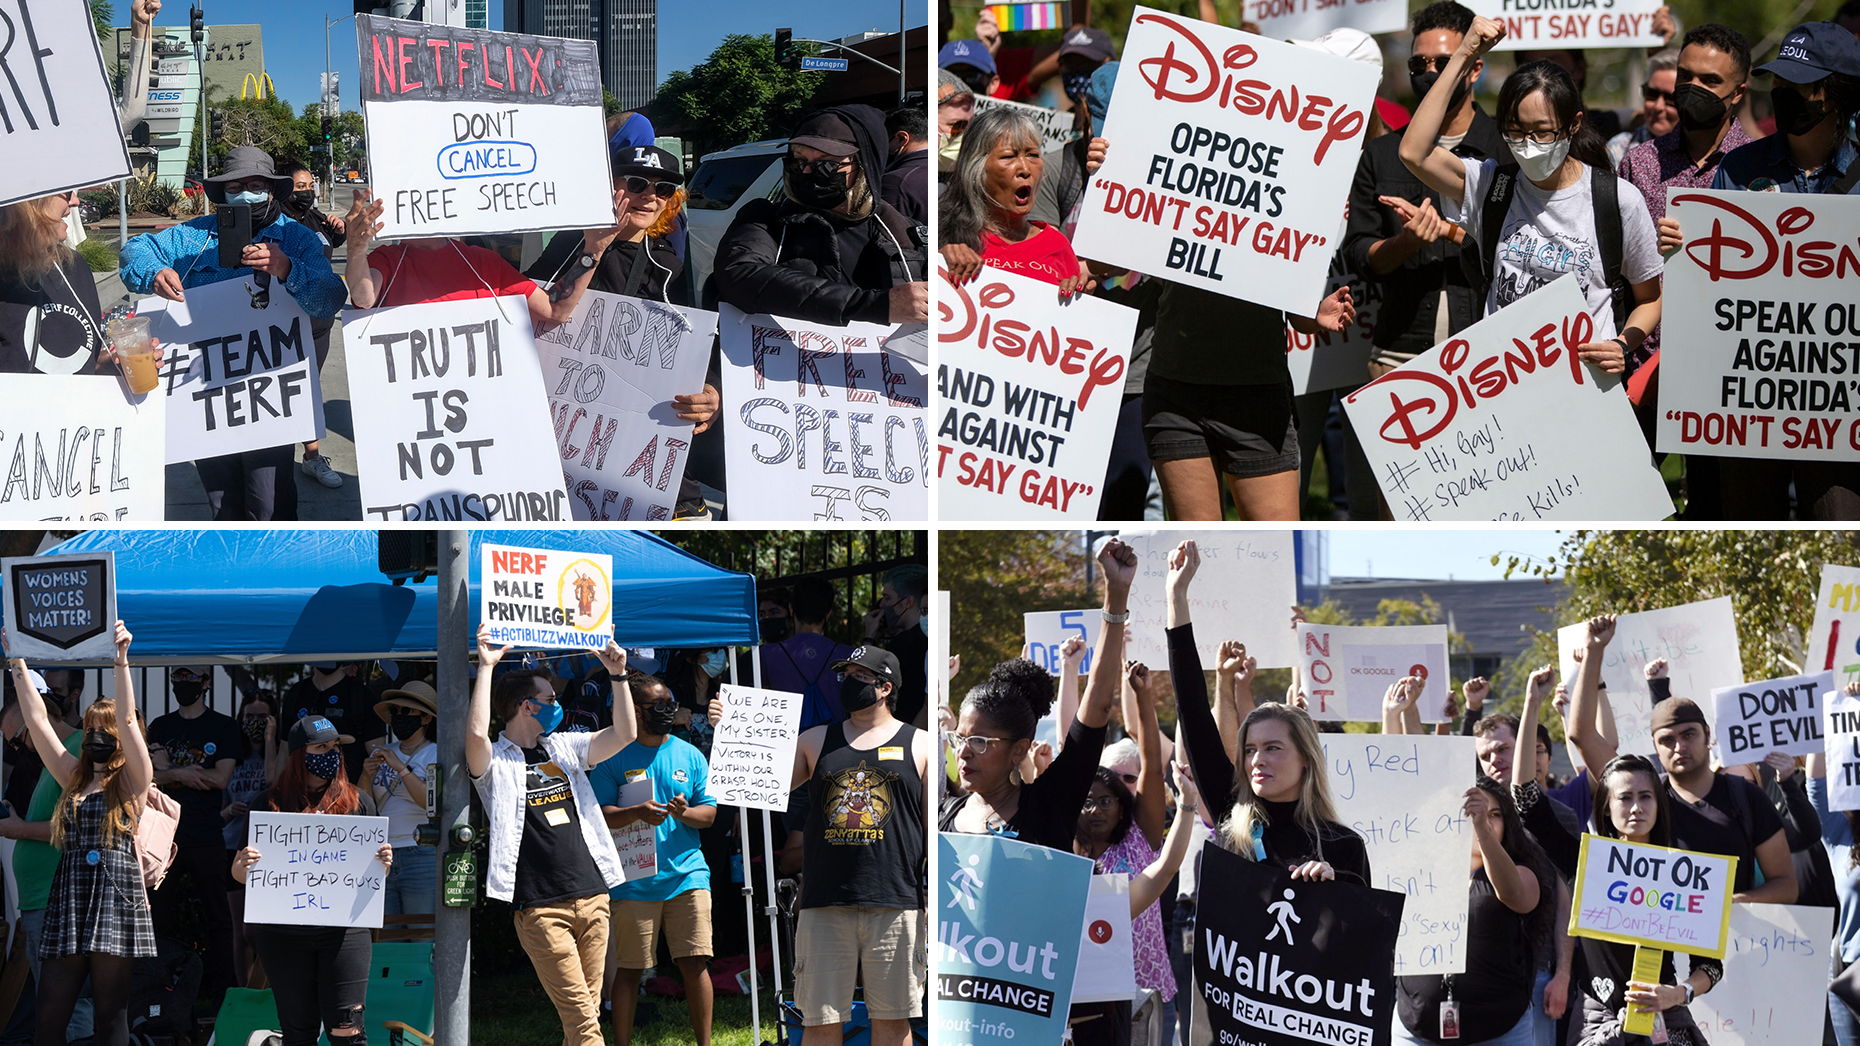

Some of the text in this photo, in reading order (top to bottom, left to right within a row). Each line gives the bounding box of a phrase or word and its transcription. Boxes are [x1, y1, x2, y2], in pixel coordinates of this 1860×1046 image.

[1549, 14, 1591, 39] SAY
[805, 59, 845, 70] De Longpre
[453, 109, 519, 142] DON'T
[449, 148, 521, 173] CANCEL
[633, 147, 663, 169] LA
[1171, 122, 1284, 178] OPPOSE
[396, 181, 557, 224] FREE SPEECH
[1147, 154, 1286, 217] FLORIDA'S
[1095, 178, 1327, 263] "DON'T SAY GAY"
[983, 258, 1060, 279] PEAK OUT
[1166, 237, 1224, 281] BILL
[63, 304, 94, 350] COLLECTIVE
[1715, 298, 1817, 335] SPEAK
[159, 316, 305, 396] #TEAM
[370, 319, 503, 383] TRUTH
[752, 325, 924, 409] FREE
[555, 357, 606, 404] TO
[1721, 375, 1860, 412] FLORIDA'
[191, 369, 307, 431] TERF
[412, 389, 469, 440] IS
[1004, 381, 1076, 432] WITH
[938, 407, 1065, 468] AGAINST
[1666, 410, 1775, 447] "DON'T
[1782, 416, 1842, 450] SAY
[0, 426, 130, 503] ANCEL
[397, 439, 494, 481] NOT
[622, 434, 689, 492] AT
[956, 452, 1016, 495] SAY
[1019, 469, 1094, 513] GAY"
[24, 569, 88, 589] WOMENS
[491, 550, 547, 575] NERF
[30, 589, 84, 608] VOICES
[493, 580, 544, 599] MALE
[28, 608, 91, 628] MATTER!
[488, 602, 576, 627] PRIVILEGE
[489, 627, 611, 648] #ACTIBLIZZWALKOUT
[730, 710, 788, 726] AS ONE,
[762, 696, 788, 709] ARE
[1738, 682, 1818, 720] DON'T
[720, 724, 741, 738] MY
[1728, 722, 1764, 753] BE
[1770, 716, 1824, 747] EVIL
[712, 764, 774, 775] WITHIN OUR
[761, 751, 773, 761] IS
[1366, 743, 1419, 775] Red
[528, 791, 573, 806] LEAGUE
[711, 775, 780, 789] GRASP. HOLD
[254, 824, 386, 846] FIGHT BAD GUYS
[288, 850, 347, 864] IN GAME
[1671, 856, 1712, 891] OK
[249, 869, 381, 891] FIGHT BAD GUYS
[1607, 880, 1705, 914] GOOGLE
[292, 893, 330, 910] IRL
[1734, 929, 1814, 967] rights
[1206, 927, 1375, 1017] Walkout
[958, 979, 1050, 1013] CHANGE
[1205, 982, 1369, 1046] FOR REAL CHANGE
